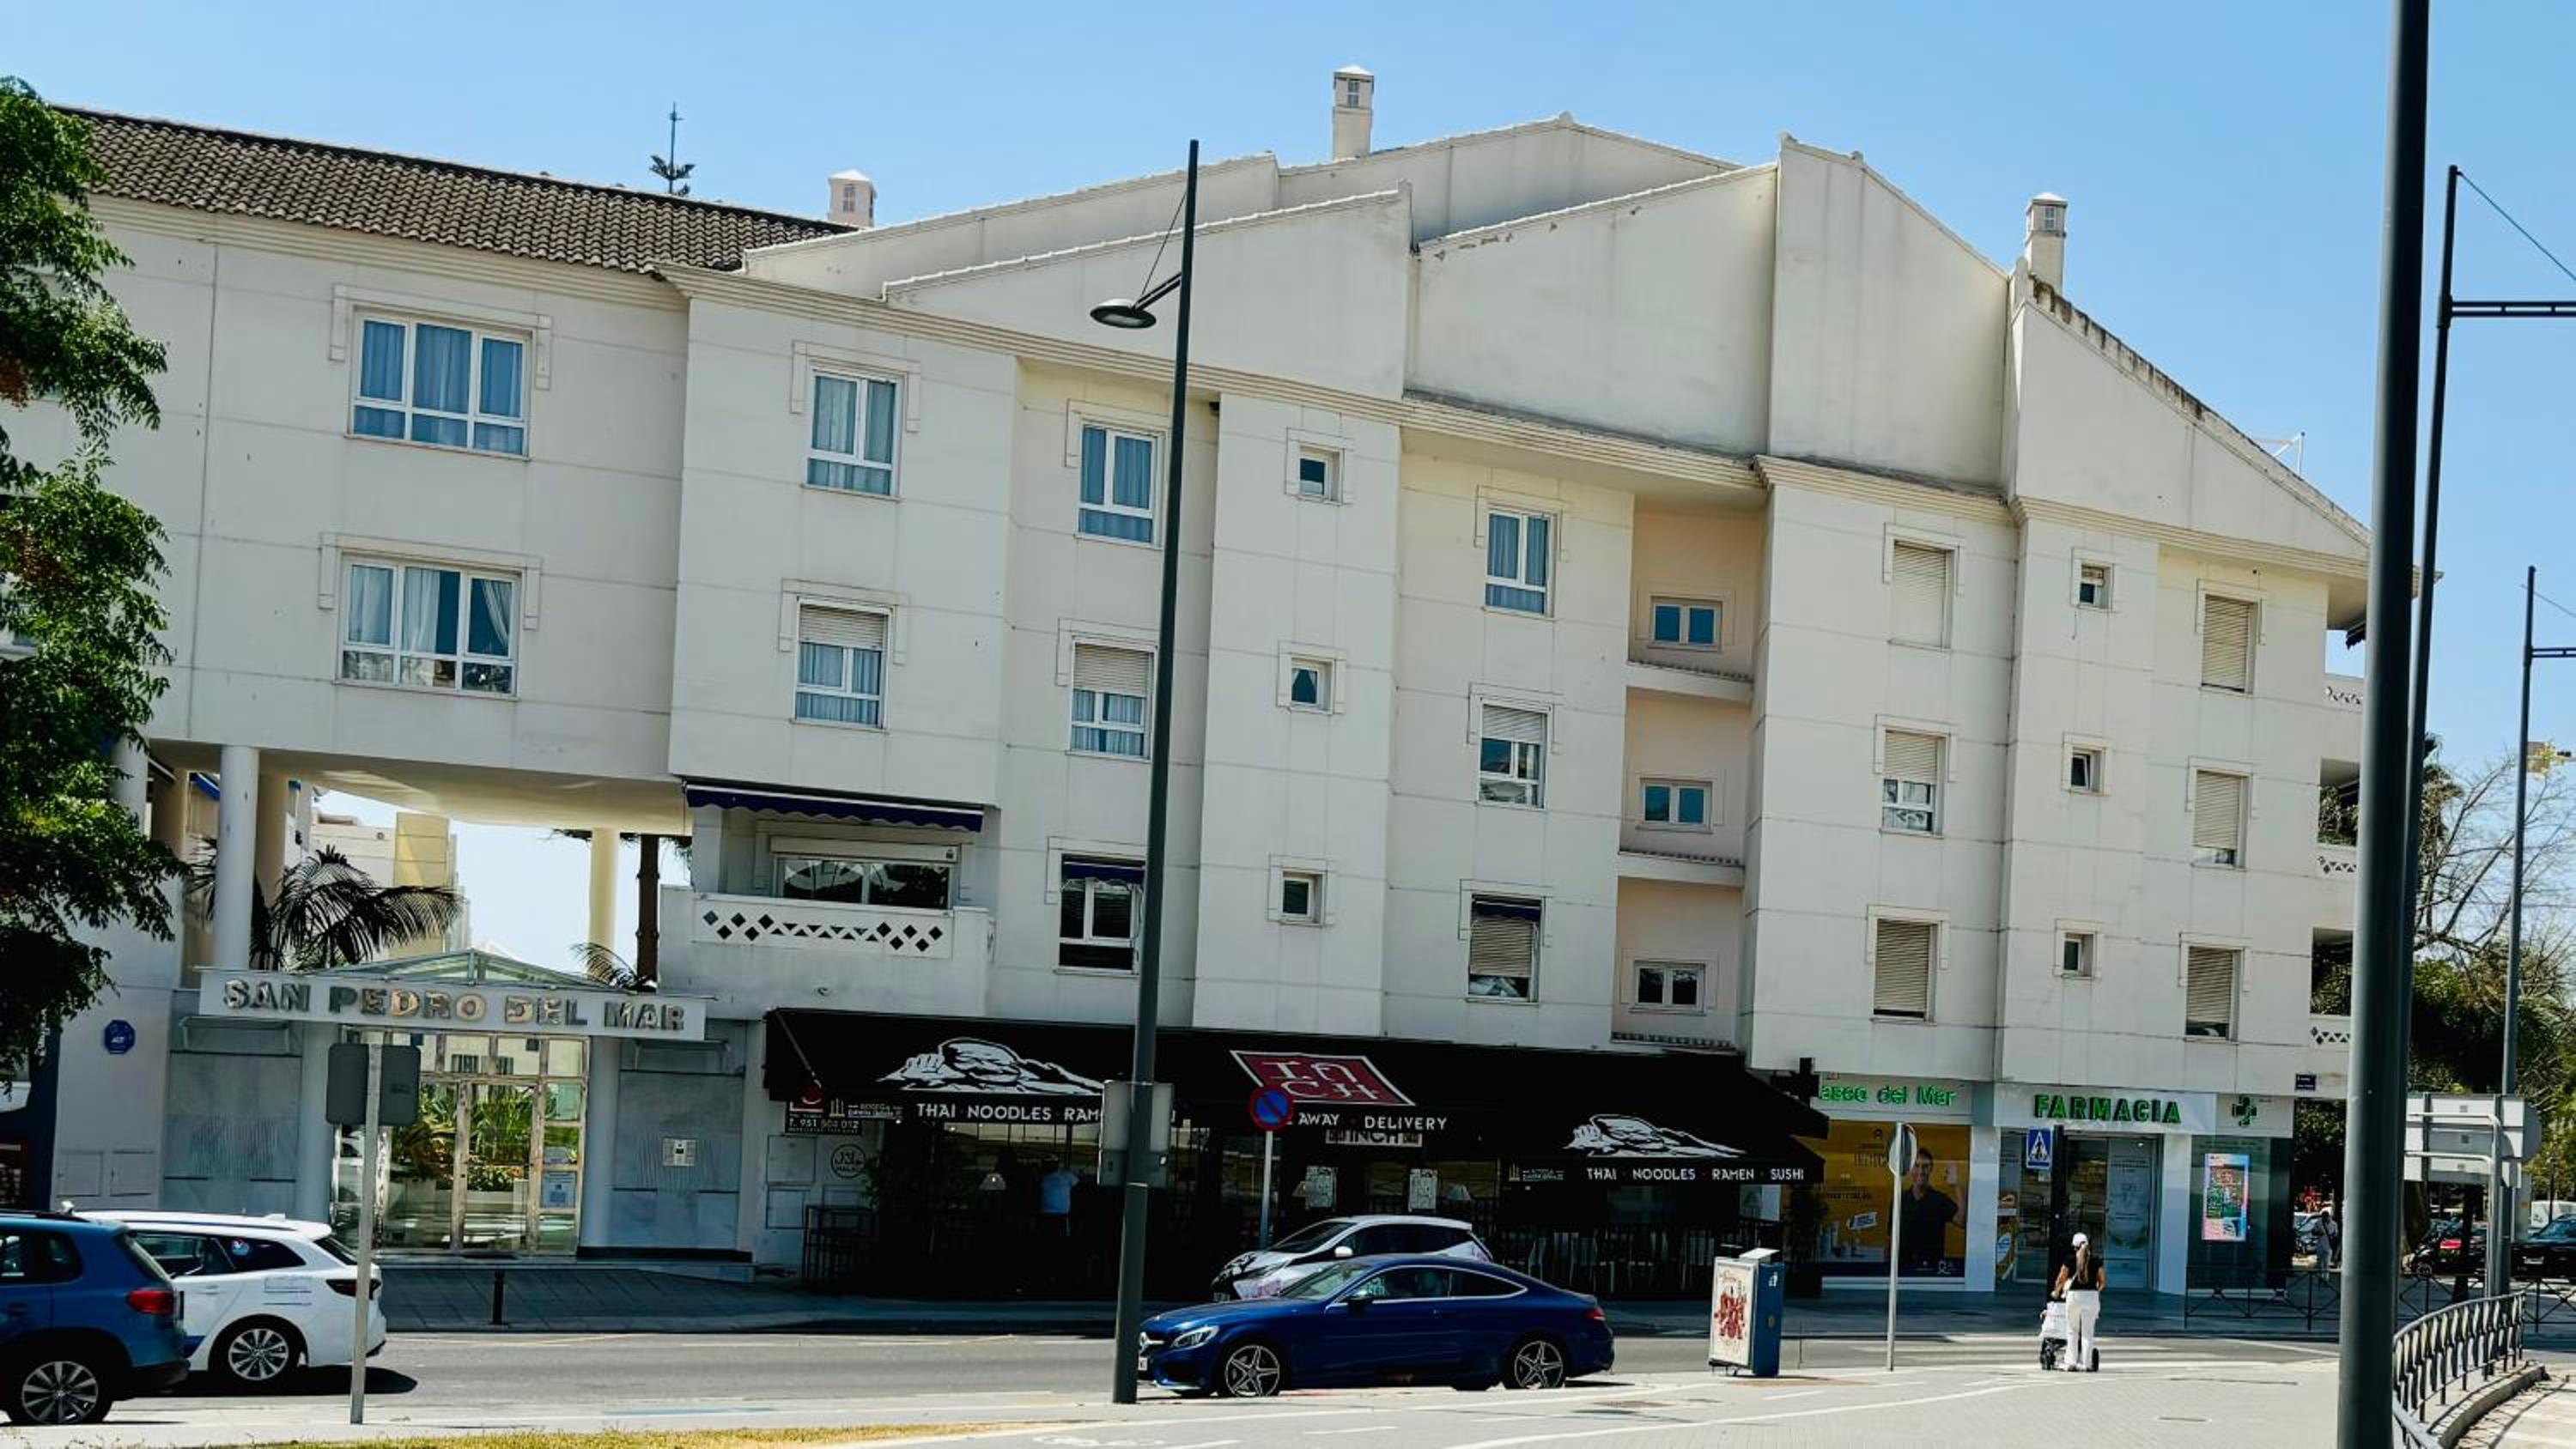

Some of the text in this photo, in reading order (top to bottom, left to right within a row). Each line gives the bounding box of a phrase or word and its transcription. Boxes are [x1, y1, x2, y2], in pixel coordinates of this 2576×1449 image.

[223, 979, 686, 1032] SAN PEDRO DEL MAR
[1819, 1084, 1959, 1106] aseo del Mar
[916, 1102, 957, 1119] THAI
[967, 1104, 1052, 1122] NOODLES
[1064, 1107, 1103, 1123] RAM
[2033, 1094, 2182, 1125] FARMACIA
[1297, 1113, 1340, 1126] AWAY
[1364, 1115, 1448, 1131] DELIVERY
[1586, 1167, 1804, 1181] THAI NOODLES RAMEN SUSHI
